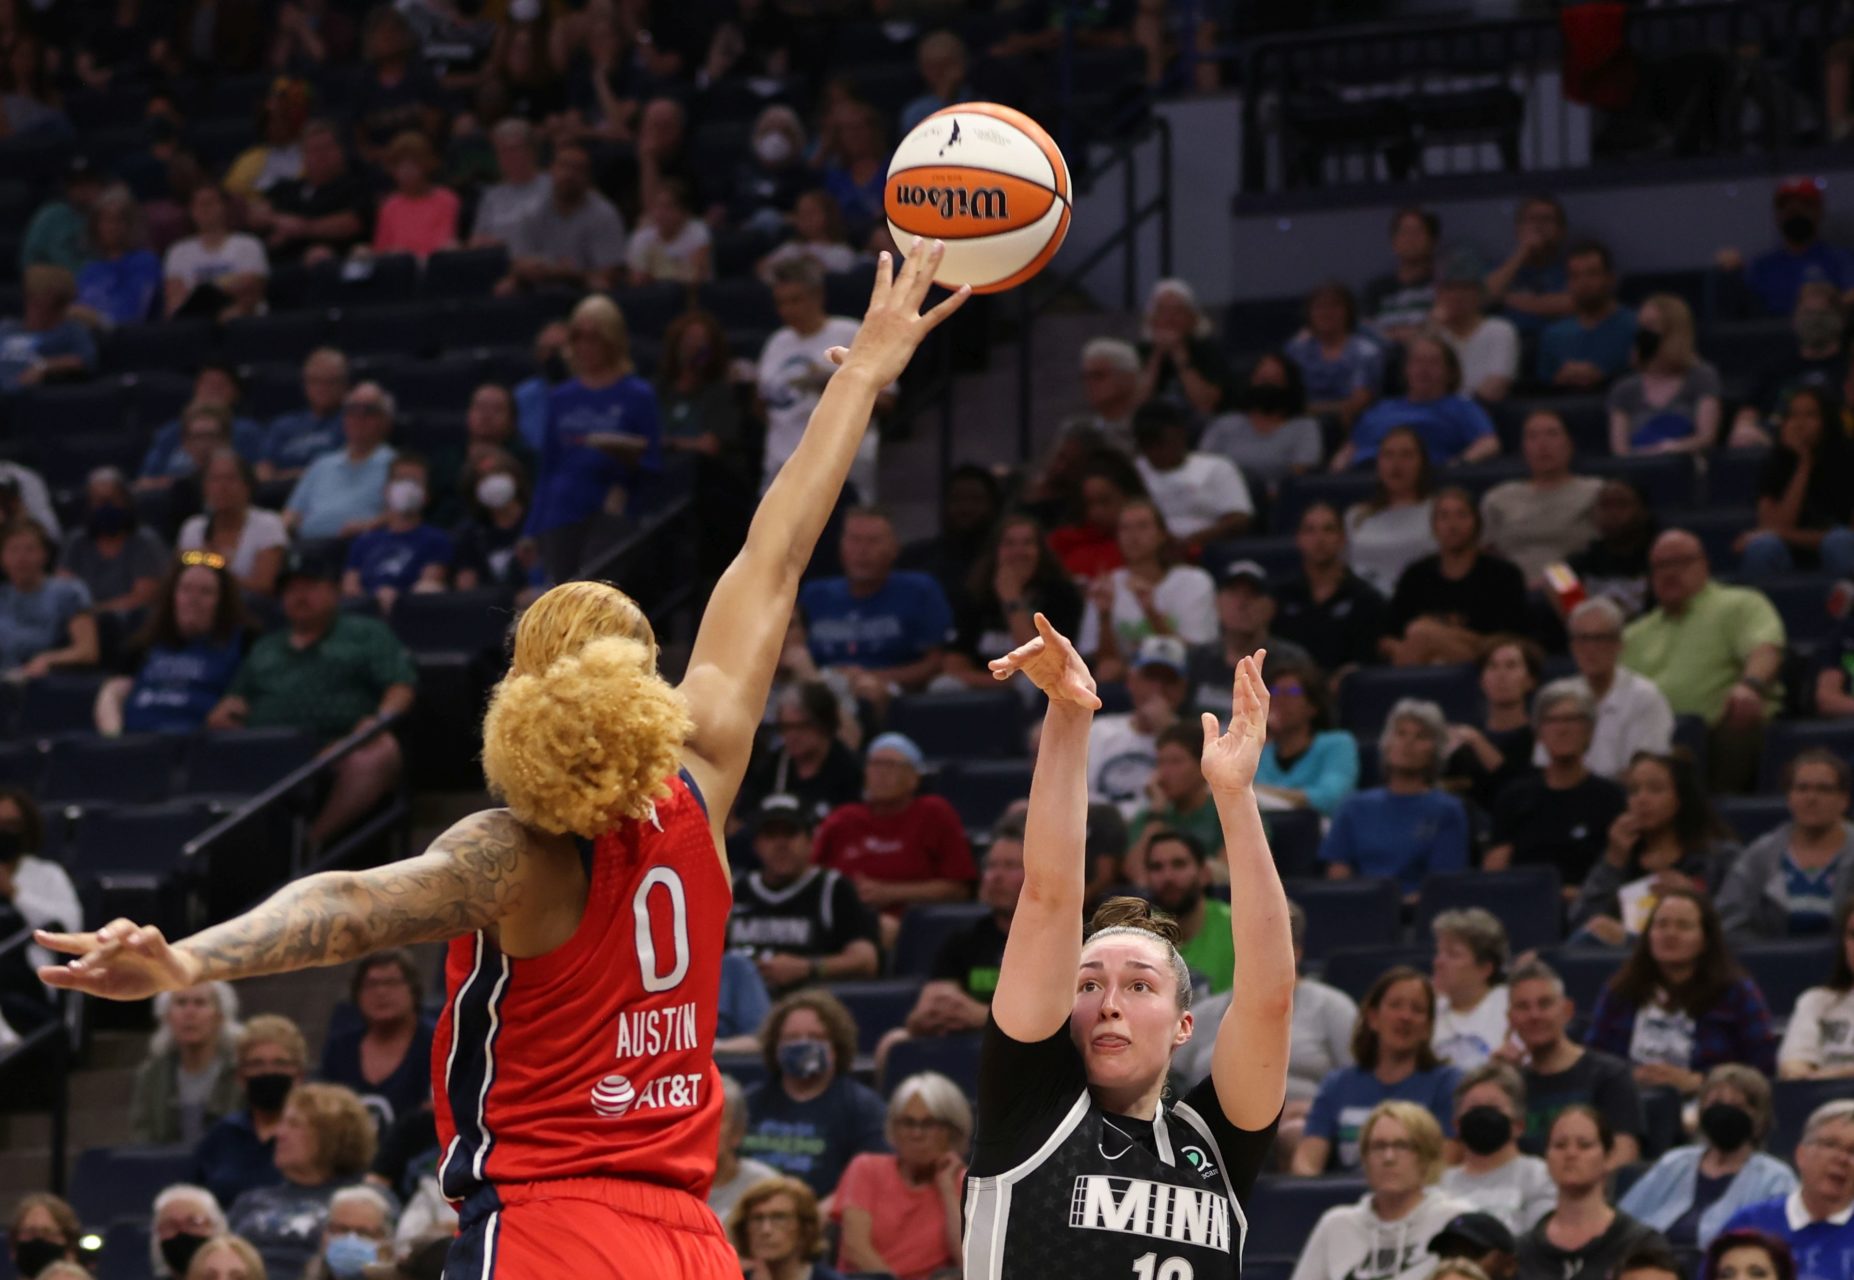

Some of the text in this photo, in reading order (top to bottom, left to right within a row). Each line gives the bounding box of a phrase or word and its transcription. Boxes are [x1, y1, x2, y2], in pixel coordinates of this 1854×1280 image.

[896, 184, 1009, 220] Wilson
[633, 865, 690, 993] 0
[615, 1002, 698, 1059] AUSTIN
[634, 1073, 702, 1111] AT&T
[1080, 1176, 1231, 1254] MINN
